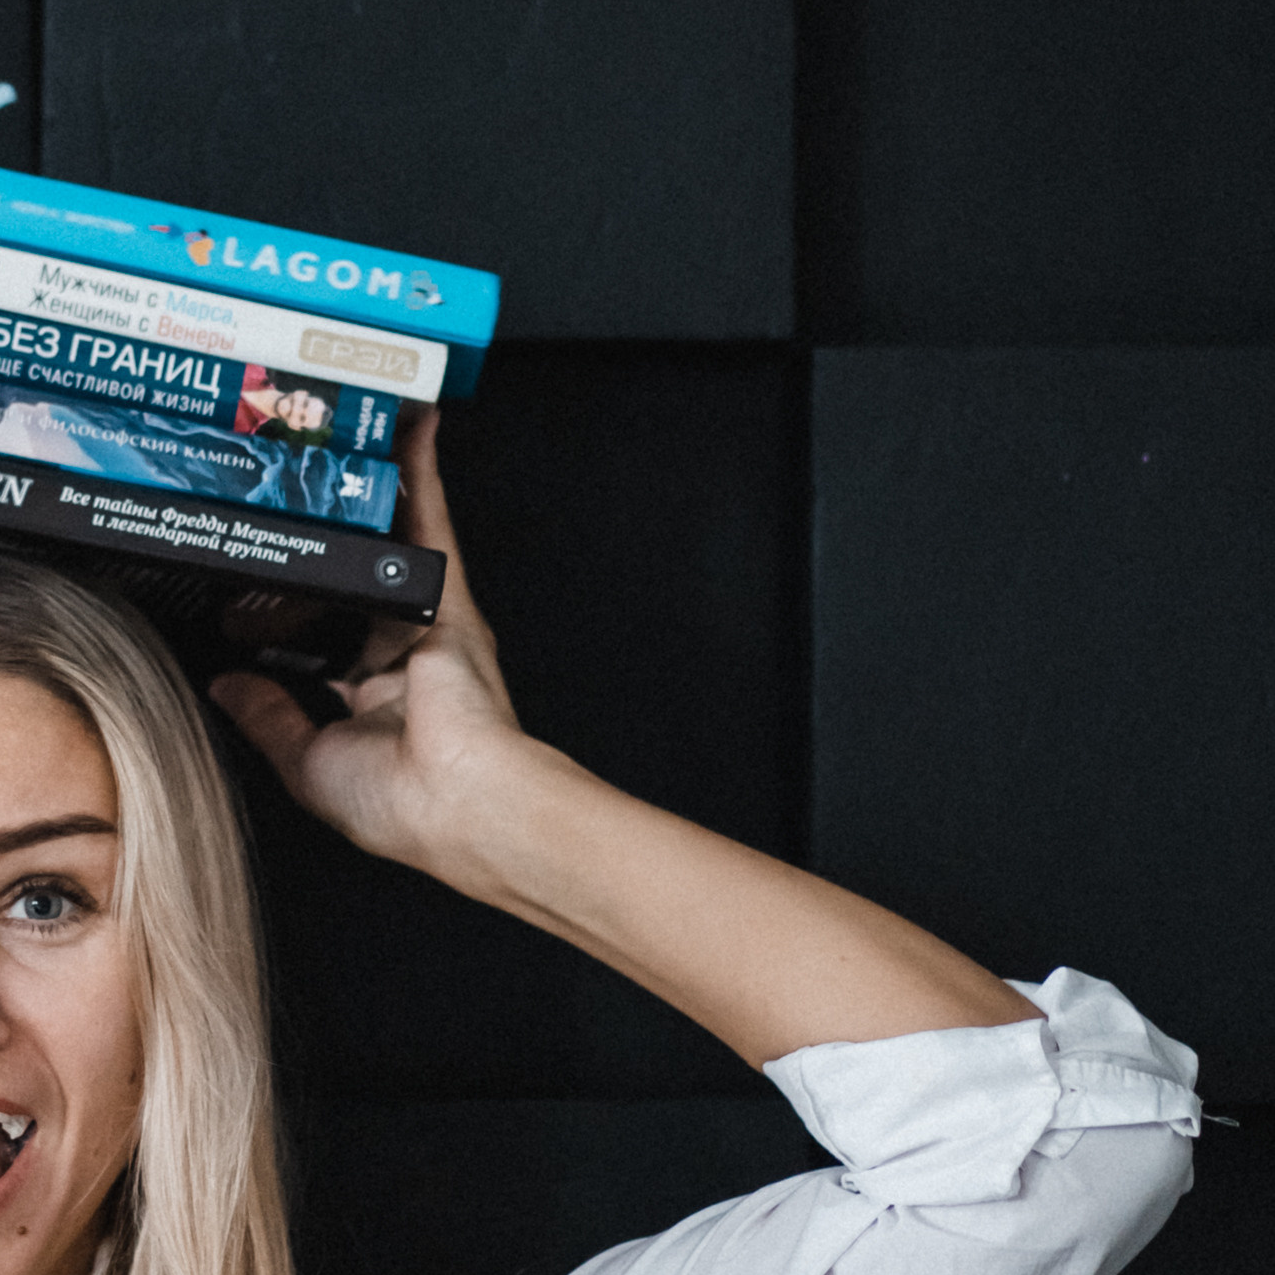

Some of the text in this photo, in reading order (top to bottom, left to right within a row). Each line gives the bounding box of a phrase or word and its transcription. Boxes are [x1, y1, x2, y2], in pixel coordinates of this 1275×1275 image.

[38, 263, 139, 303] Мужчины
[147, 292, 158, 309] с
[223, 236, 402, 300] LAGOM
[28, 287, 236, 351] Женщины с Венеры
[28, 362, 146, 402] СЧАСТЛИВОЙ
[151, 389, 216, 417] ЖИЗНИ
[68, 332, 222, 400] ГРАНИЦ
[59, 486, 326, 555] Все тайны Фредди Меркьюри
[92, 513, 289, 564] и легендарной группы
